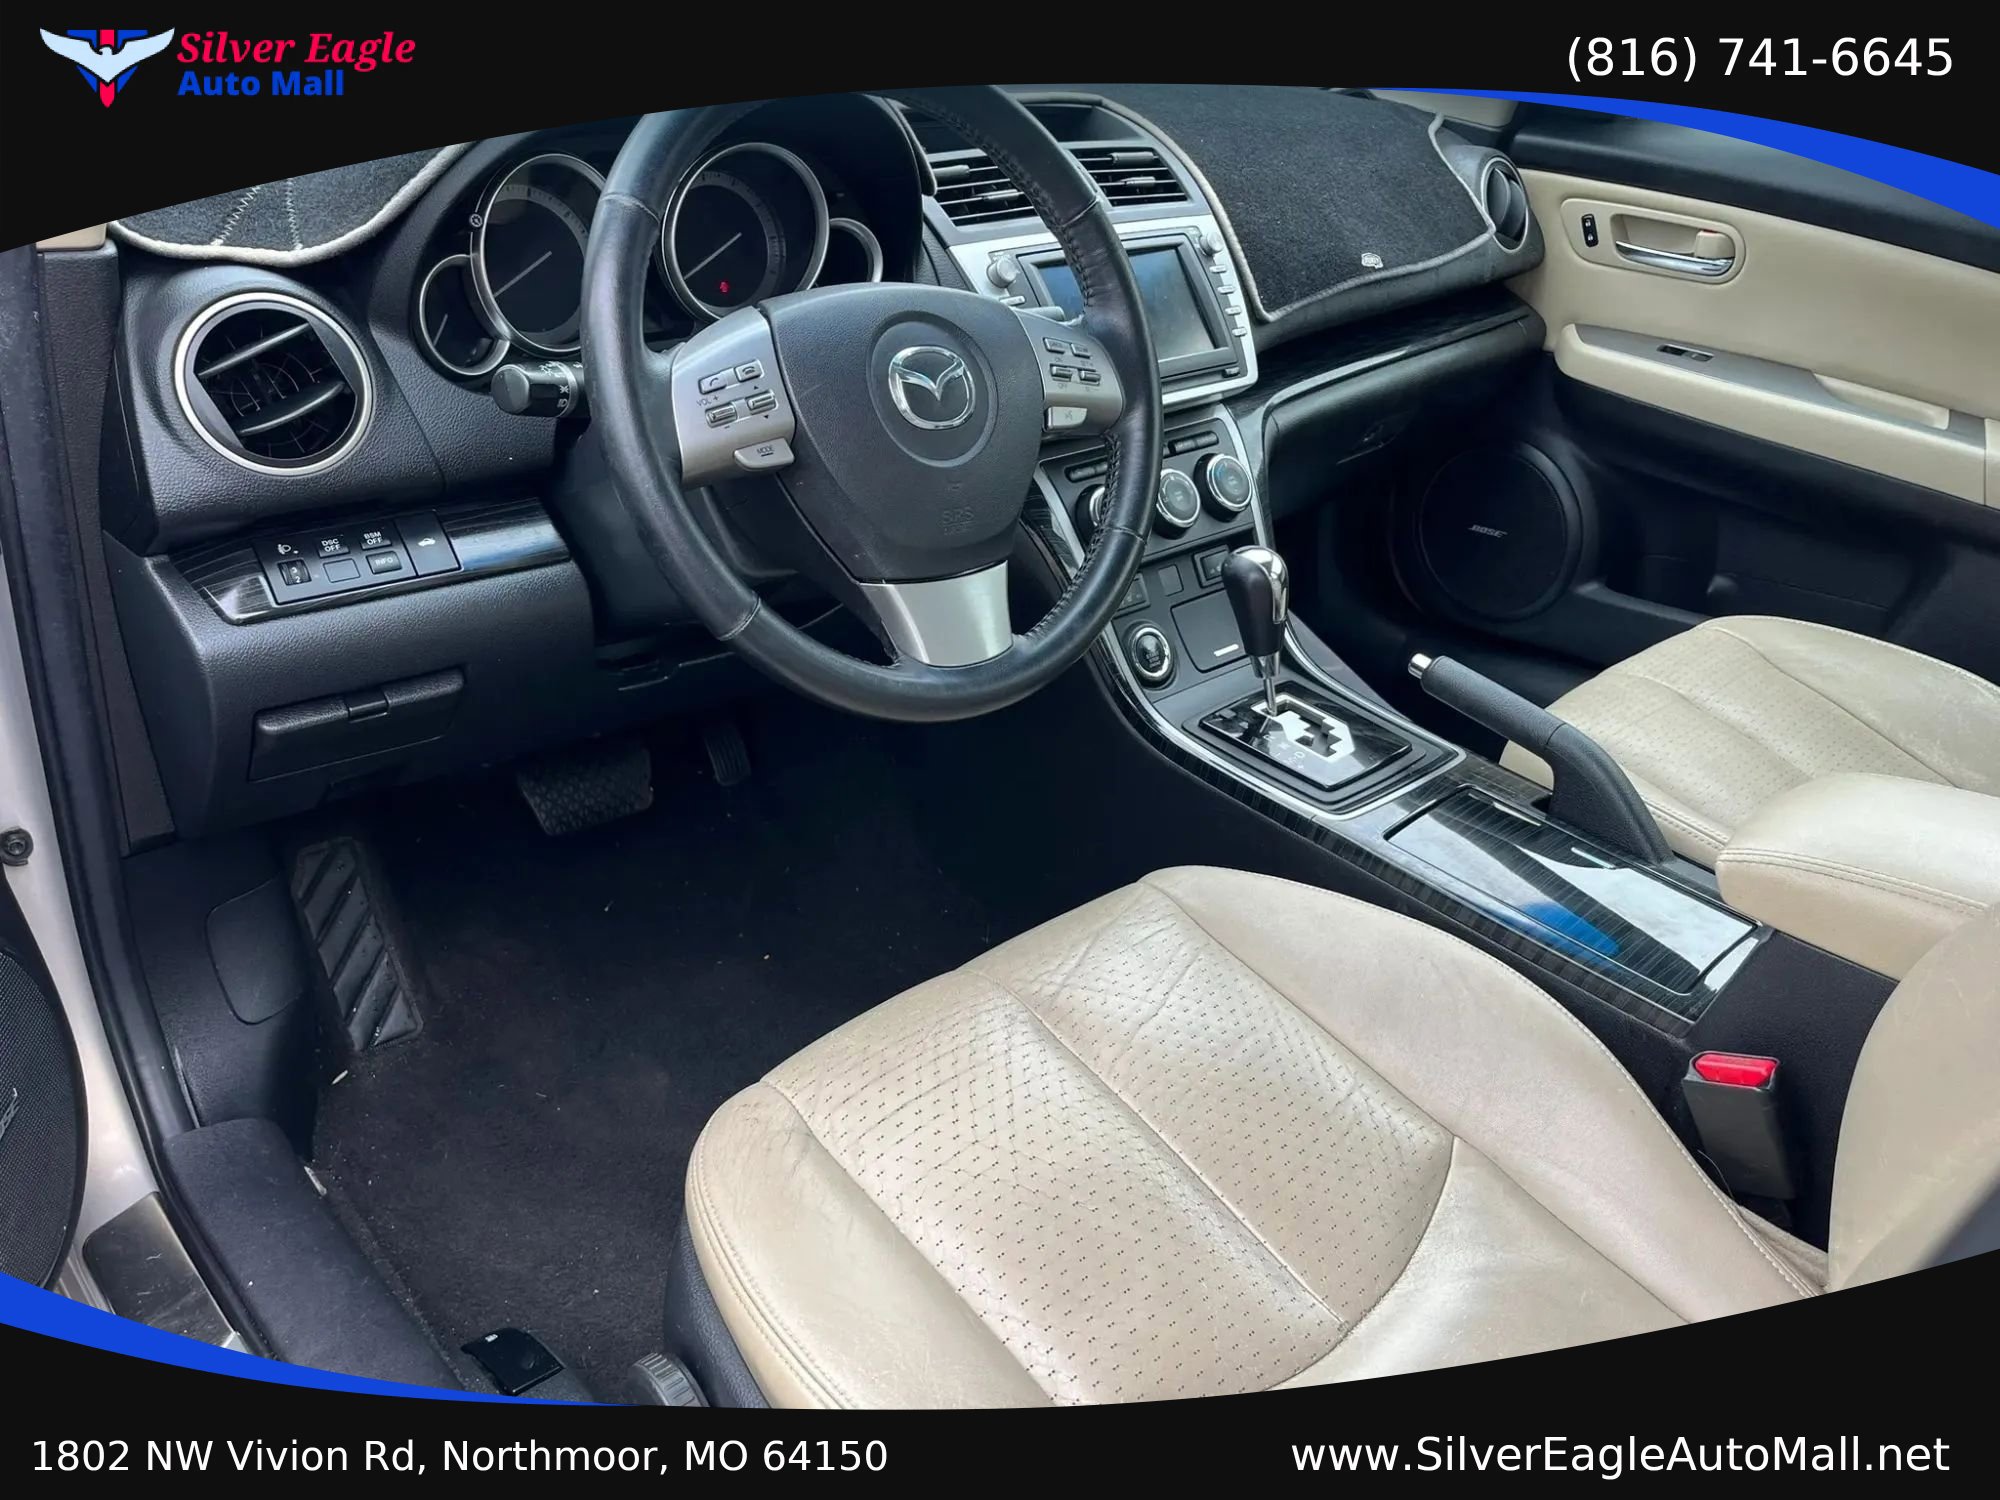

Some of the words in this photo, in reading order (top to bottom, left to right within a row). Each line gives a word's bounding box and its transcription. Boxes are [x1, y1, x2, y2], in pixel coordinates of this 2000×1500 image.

[363, 531, 382, 540] BSM
[1468, 524, 1508, 538] BOSE
[321, 538, 340, 547] DSC
[366, 537, 382, 546] OFF
[324, 545, 341, 553] OFF
